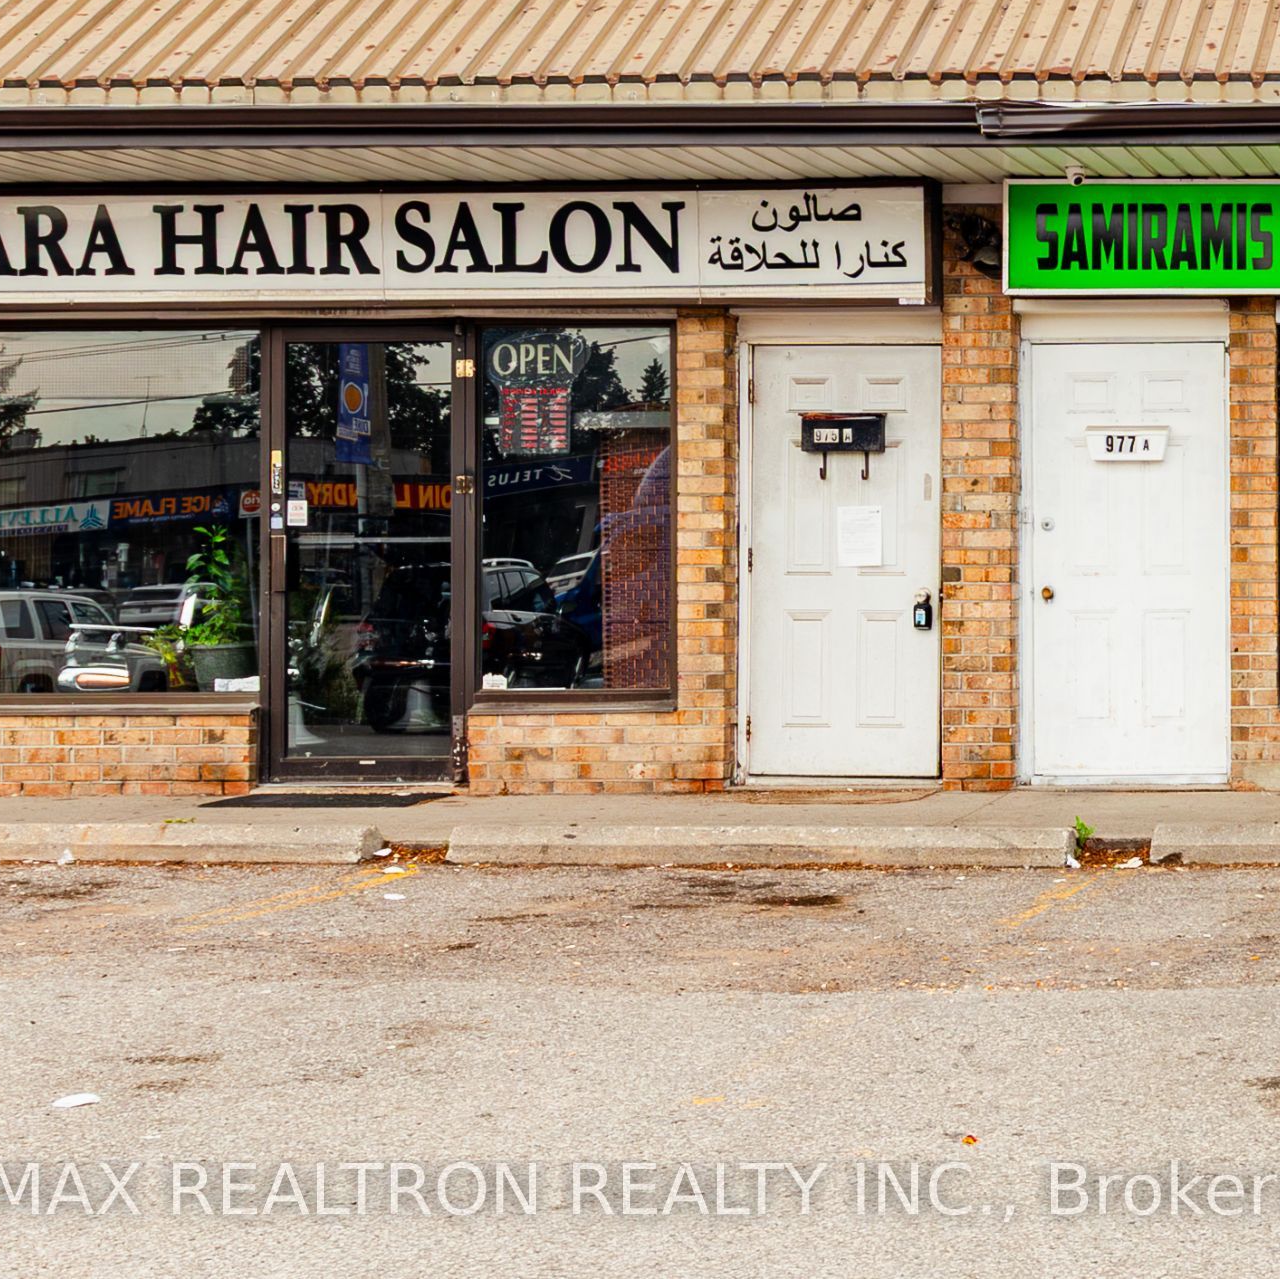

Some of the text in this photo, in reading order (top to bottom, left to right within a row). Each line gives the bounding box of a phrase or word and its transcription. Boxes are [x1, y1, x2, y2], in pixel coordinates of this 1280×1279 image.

[751, 192, 862, 232] صالون
[152, 203, 380, 276] HAIR
[395, 200, 686, 275] SALON
[707, 235, 908, 279] كنارا للحلاقة
[1035, 202, 1274, 271] SAMIRAMIS
[492, 343, 574, 376] OPEN
[1106, 435, 1149, 453] 977 A
